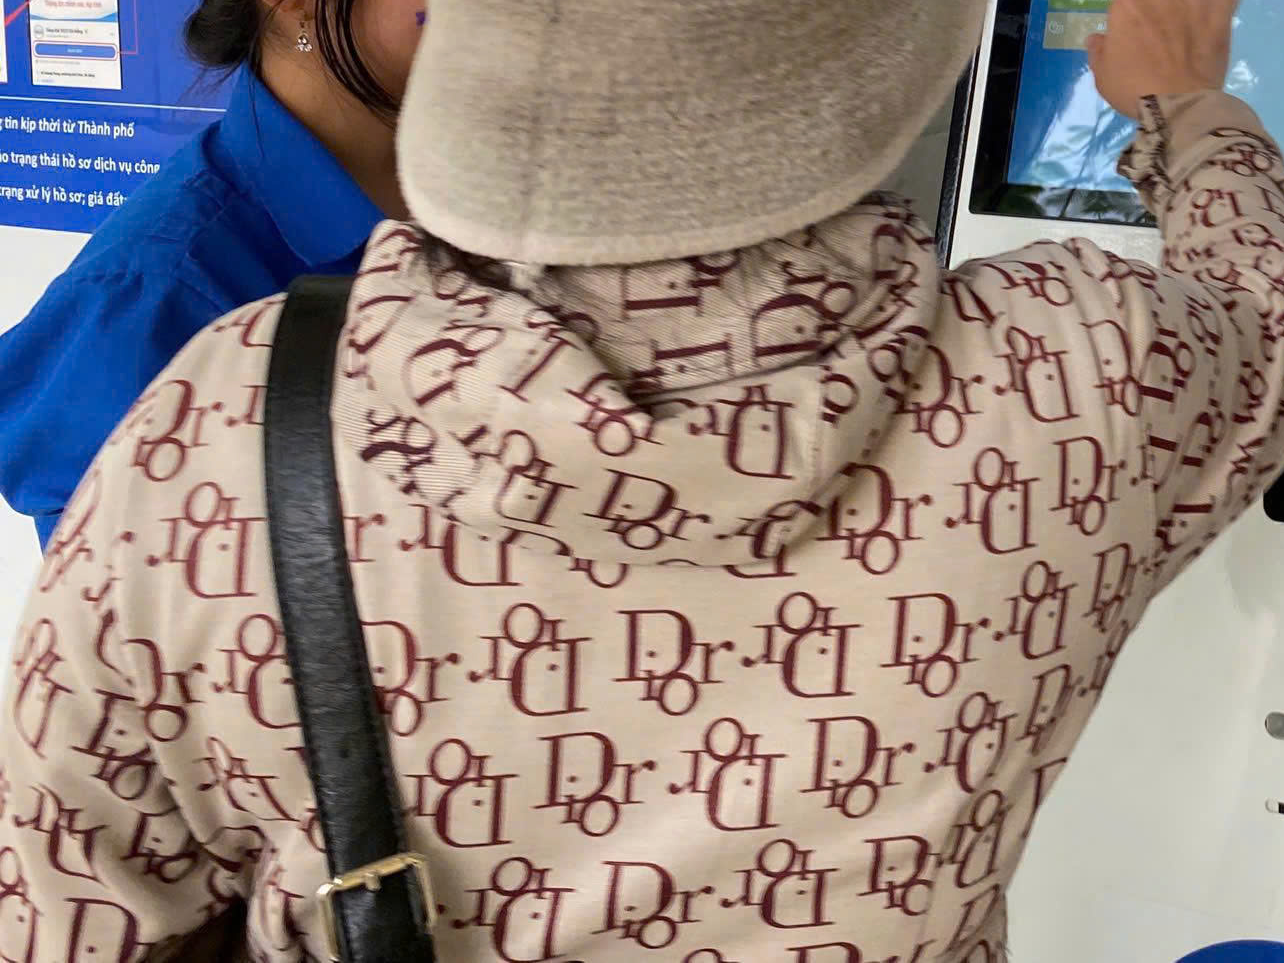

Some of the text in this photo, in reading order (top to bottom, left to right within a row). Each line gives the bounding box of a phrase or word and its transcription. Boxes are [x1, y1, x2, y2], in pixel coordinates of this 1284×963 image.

[5, 116, 135, 139] tin kịp thời từ Thành phố
[10, 151, 38, 168] trạng
[40, 152, 60, 167] thái
[62, 153, 76, 169] hồ
[78, 158, 92, 169] sơ
[94, 156, 116, 173] dịch
[119, 161, 132, 175] vụ
[25, 184, 39, 199] xử
[41, 186, 51, 204] lý
[53, 187, 67, 203] hồ
[88, 190, 104, 207] giá
